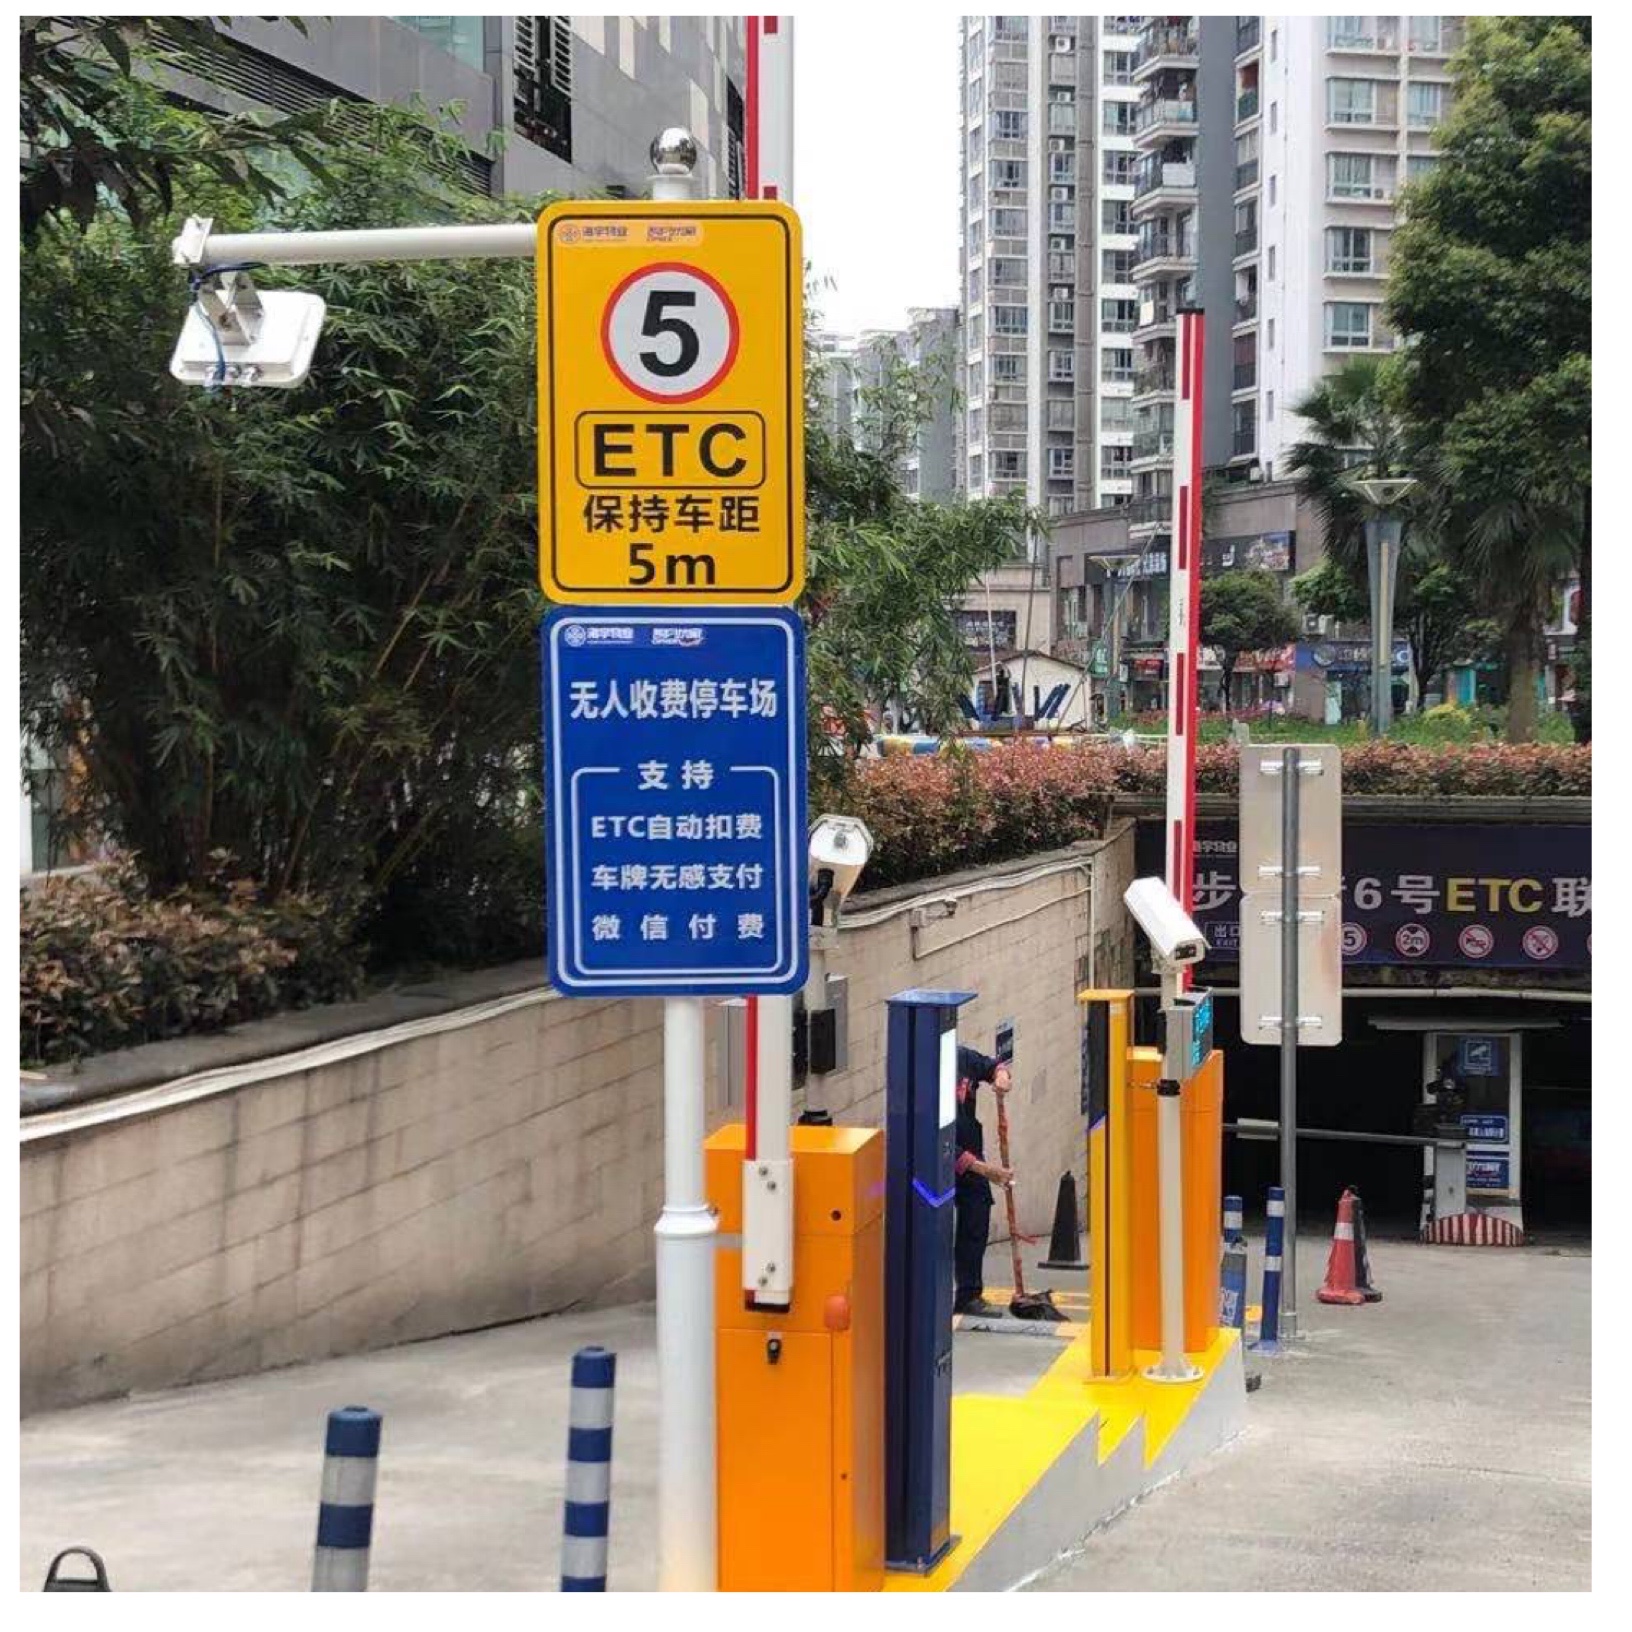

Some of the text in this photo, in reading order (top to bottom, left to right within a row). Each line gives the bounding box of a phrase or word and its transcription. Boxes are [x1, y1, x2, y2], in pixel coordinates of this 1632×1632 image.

[639, 290, 700, 377] 5
[593, 423, 747, 477] ETC
[583, 494, 760, 533] 保持车距
[628, 542, 715, 585] 5m
[569, 678, 778, 719] 无人收费停车场
[637, 759, 715, 791] 支持
[591, 814, 762, 840] ETC自动扣费
[590, 863, 763, 891] 车牌无感支付
[591, 914, 765, 941] 微信付费
